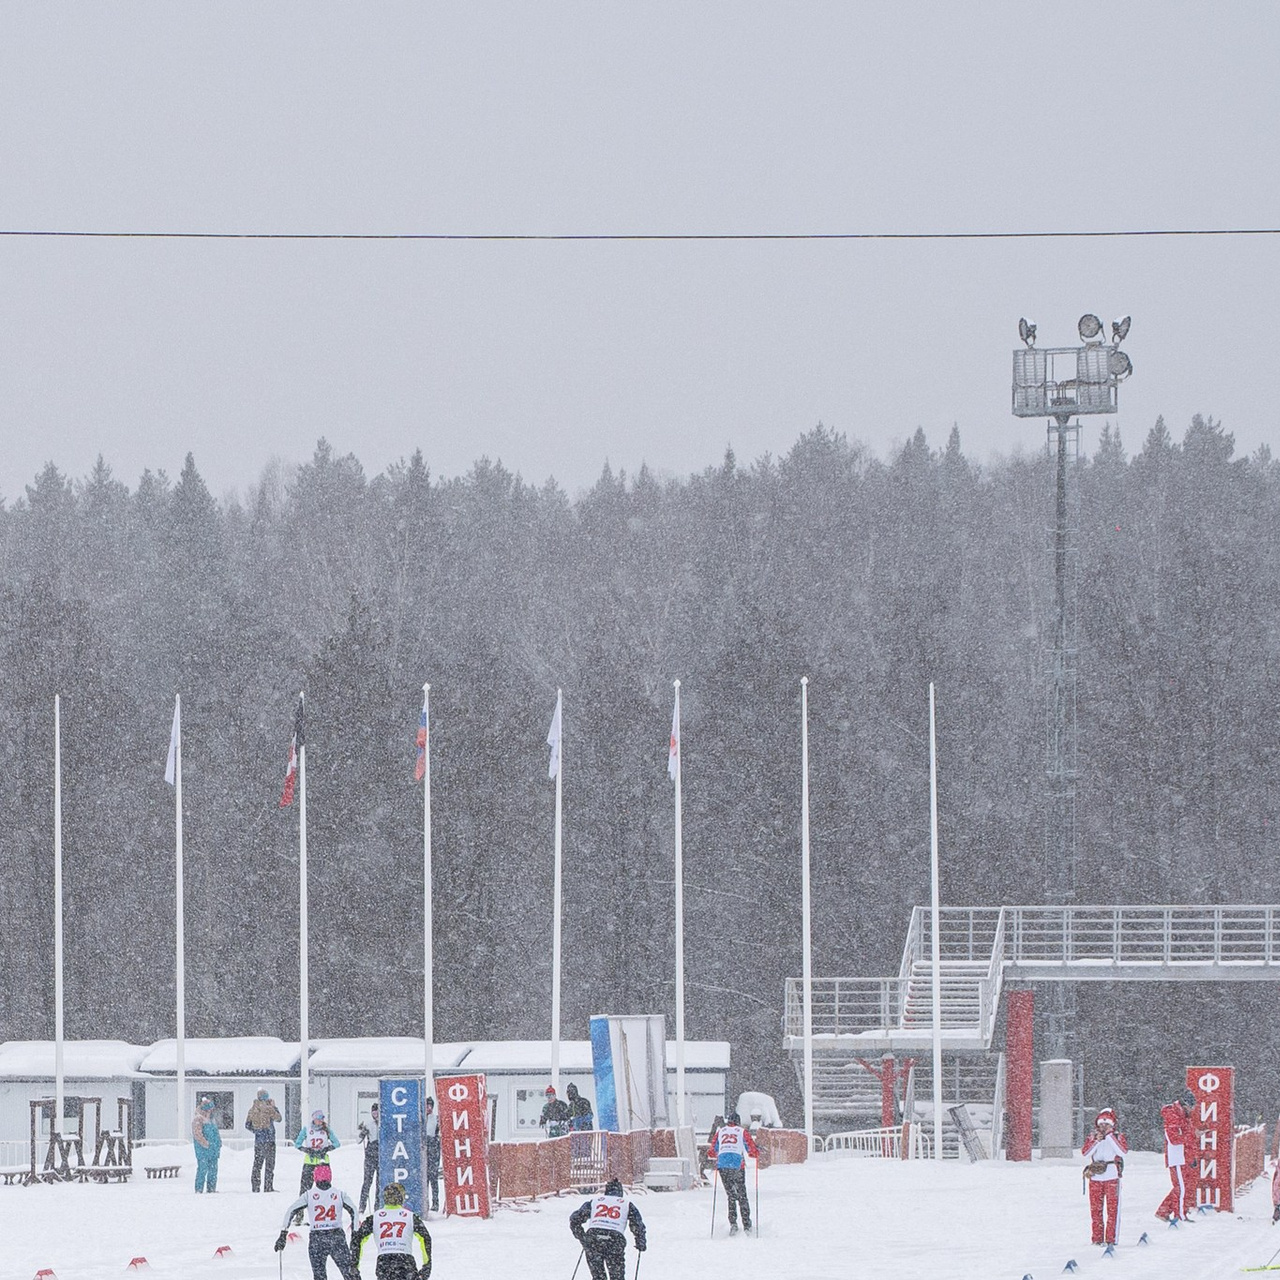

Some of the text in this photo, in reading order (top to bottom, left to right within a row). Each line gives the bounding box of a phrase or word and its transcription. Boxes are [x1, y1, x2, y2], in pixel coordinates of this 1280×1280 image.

[310, 1138, 324, 1149] 12
[391, 1087, 410, 1199] СТАР
[721, 1133, 738, 1145] 25
[1196, 1073, 1221, 1208] ФИНИШ
[448, 1083, 479, 1214] ФИНИШ
[314, 1204, 337, 1221] 24
[594, 1203, 621, 1219] 26
[379, 1221, 407, 1239] 27
